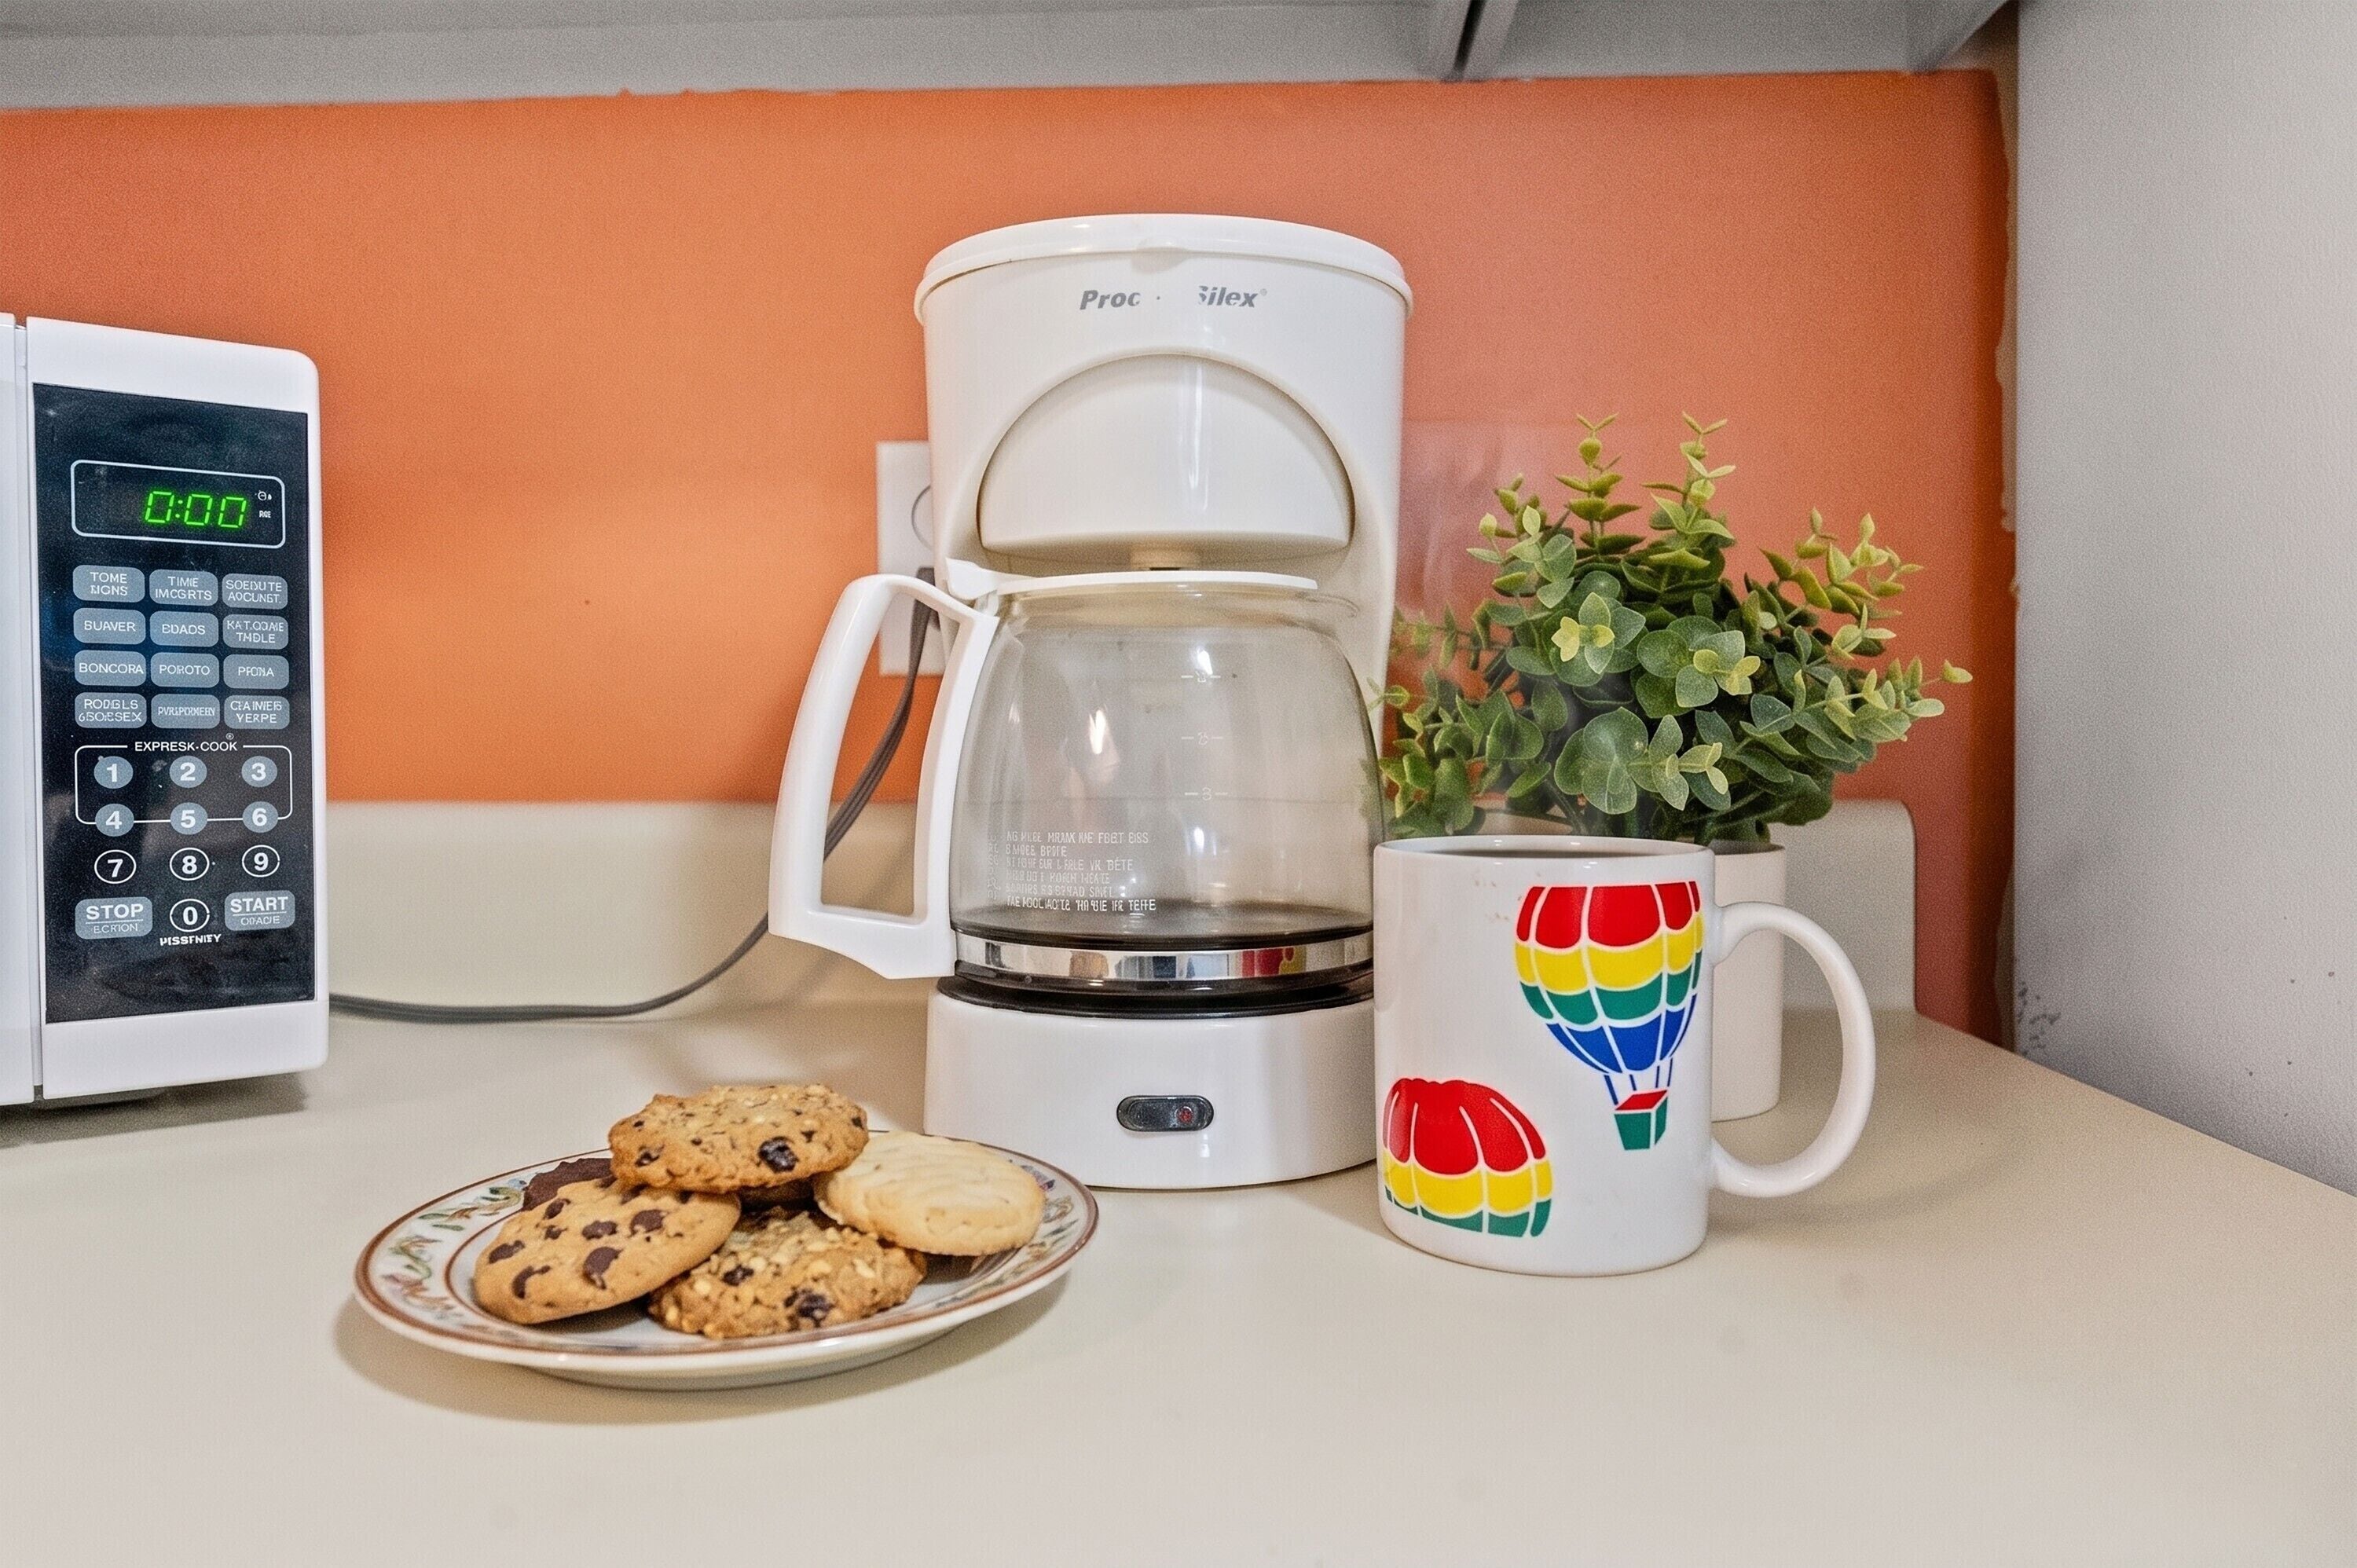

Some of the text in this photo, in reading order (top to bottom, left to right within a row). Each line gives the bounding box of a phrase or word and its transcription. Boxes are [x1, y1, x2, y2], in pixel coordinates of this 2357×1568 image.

[145, 490, 247, 529] 0:00
[90, 572, 128, 584] TOME
[79, 662, 145, 674] BONCORA
[106, 764, 118, 782] 1
[180, 762, 196, 781] 2
[251, 762, 266, 781] 3
[105, 810, 123, 830] 4
[181, 809, 196, 828] 5
[251, 808, 268, 826] 6
[107, 859, 123, 877] 7
[181, 855, 197, 874] 8
[253, 852, 269, 871] 9
[86, 903, 144, 920] STOP
[230, 896, 288, 913] START
[182, 906, 198, 925] 0
